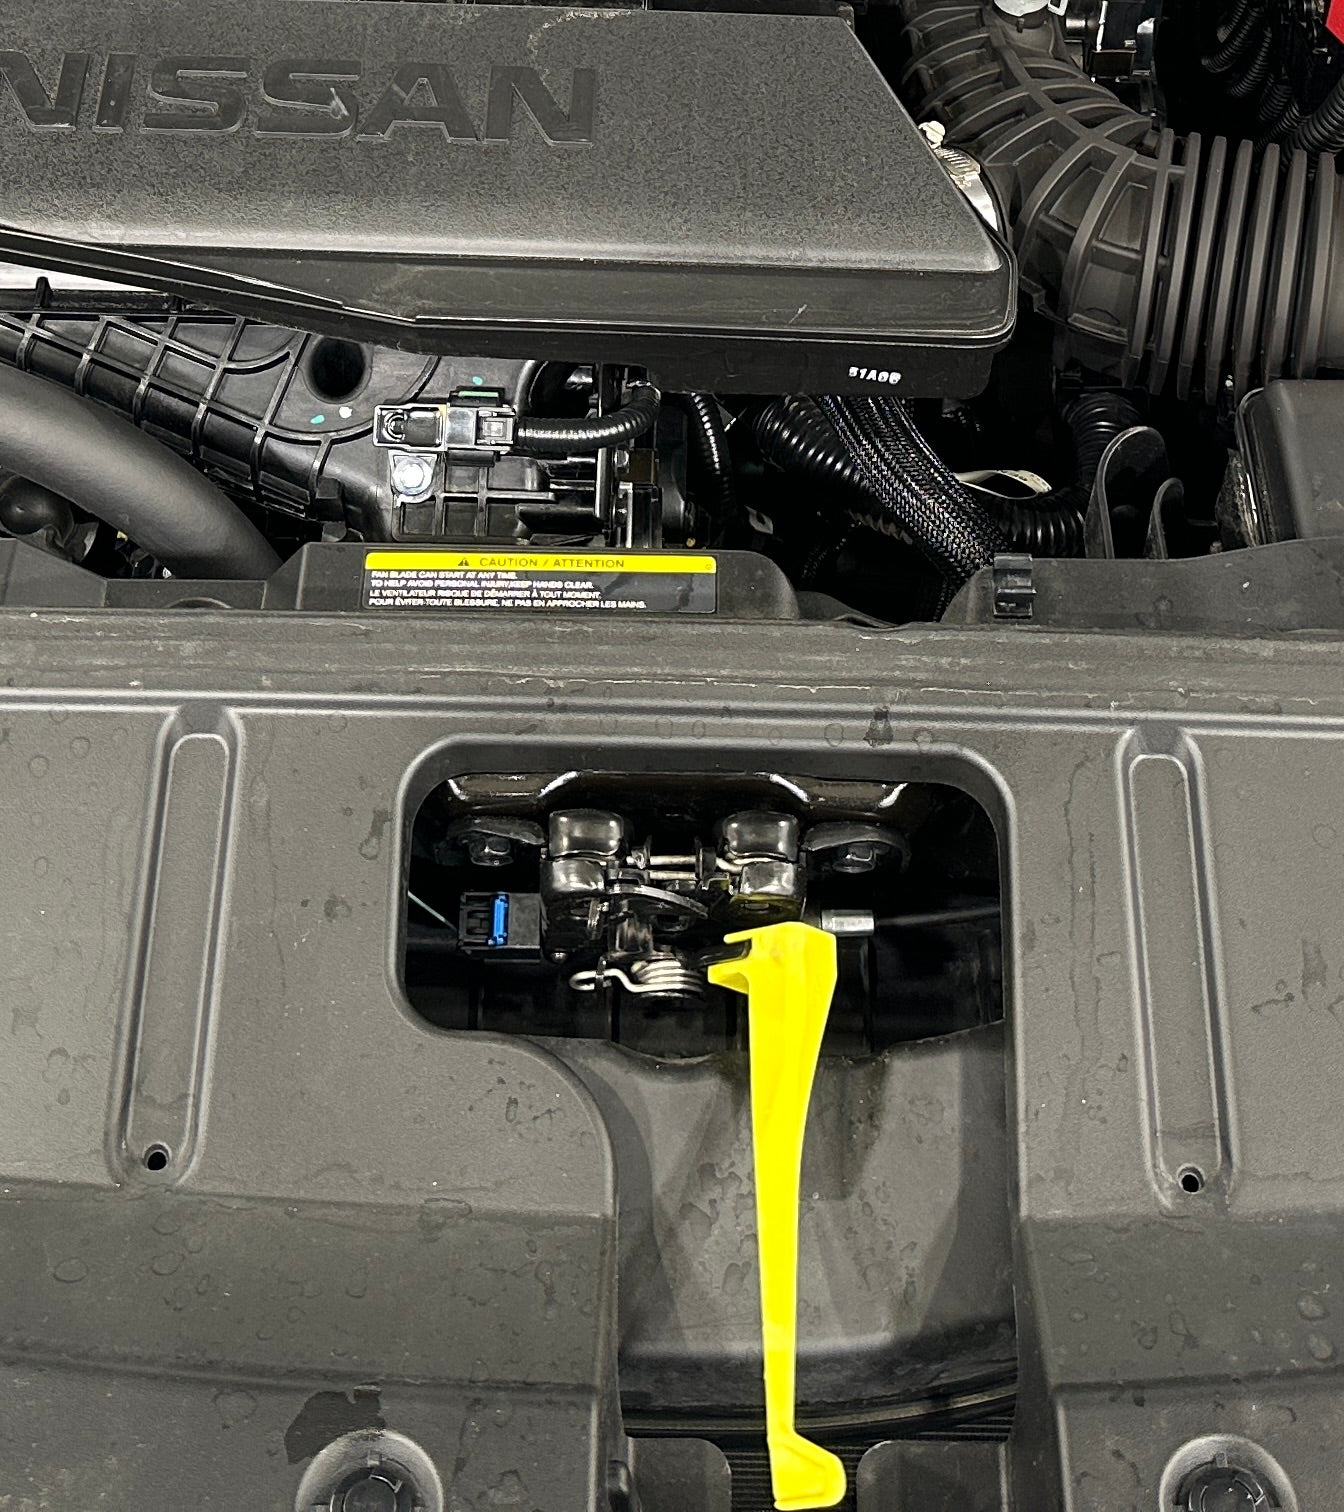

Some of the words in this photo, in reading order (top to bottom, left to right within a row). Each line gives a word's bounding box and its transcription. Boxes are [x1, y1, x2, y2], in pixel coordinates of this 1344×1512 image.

[479, 557, 537, 567] CAUTION
[553, 558, 625, 568] ATTENTION
[371, 571, 389, 579] FAN
[390, 571, 417, 579] BLADE
[418, 571, 437, 579] CAN
[439, 571, 464, 579] START
[465, 571, 477, 579] AT
[478, 571, 495, 579] ANY
[384, 580, 406, 588] HELP
[407, 580, 433, 588] AVOID
[434, 580, 480, 588] PERSONAL
[533, 581, 563, 589] HANDS
[437, 590, 468, 598] RISQUE
[471, 590, 483, 598] DE
[540, 590, 560, 598] TOUT
[369, 598, 394, 606] POUR
[501, 599, 514, 607] NE
[515, 599, 532, 607] PAS
[546, 600, 600, 608] APPROCHER
[601, 600, 616, 608] LES
